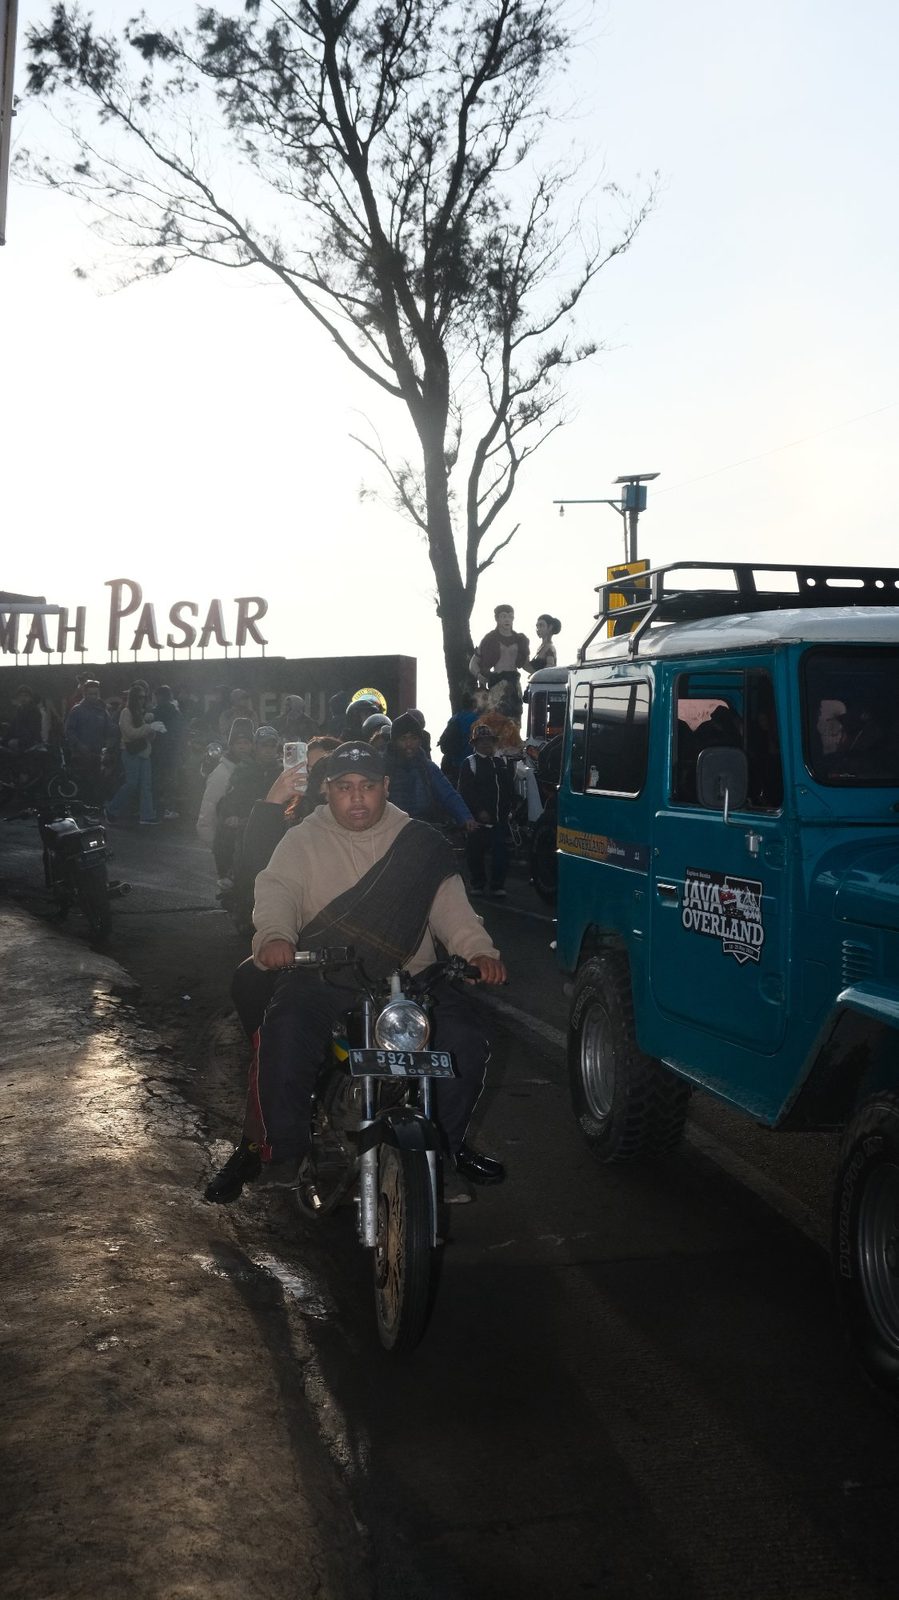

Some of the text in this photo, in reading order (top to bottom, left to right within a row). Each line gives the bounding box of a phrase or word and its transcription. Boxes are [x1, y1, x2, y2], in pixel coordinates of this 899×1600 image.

[104, 578, 269, 651] PASAR
[682, 878, 725, 914] JAVA
[682, 907, 765, 946] OVERLAND
[353, 1052, 364, 1063] N
[376, 1051, 415, 1066] 5921
